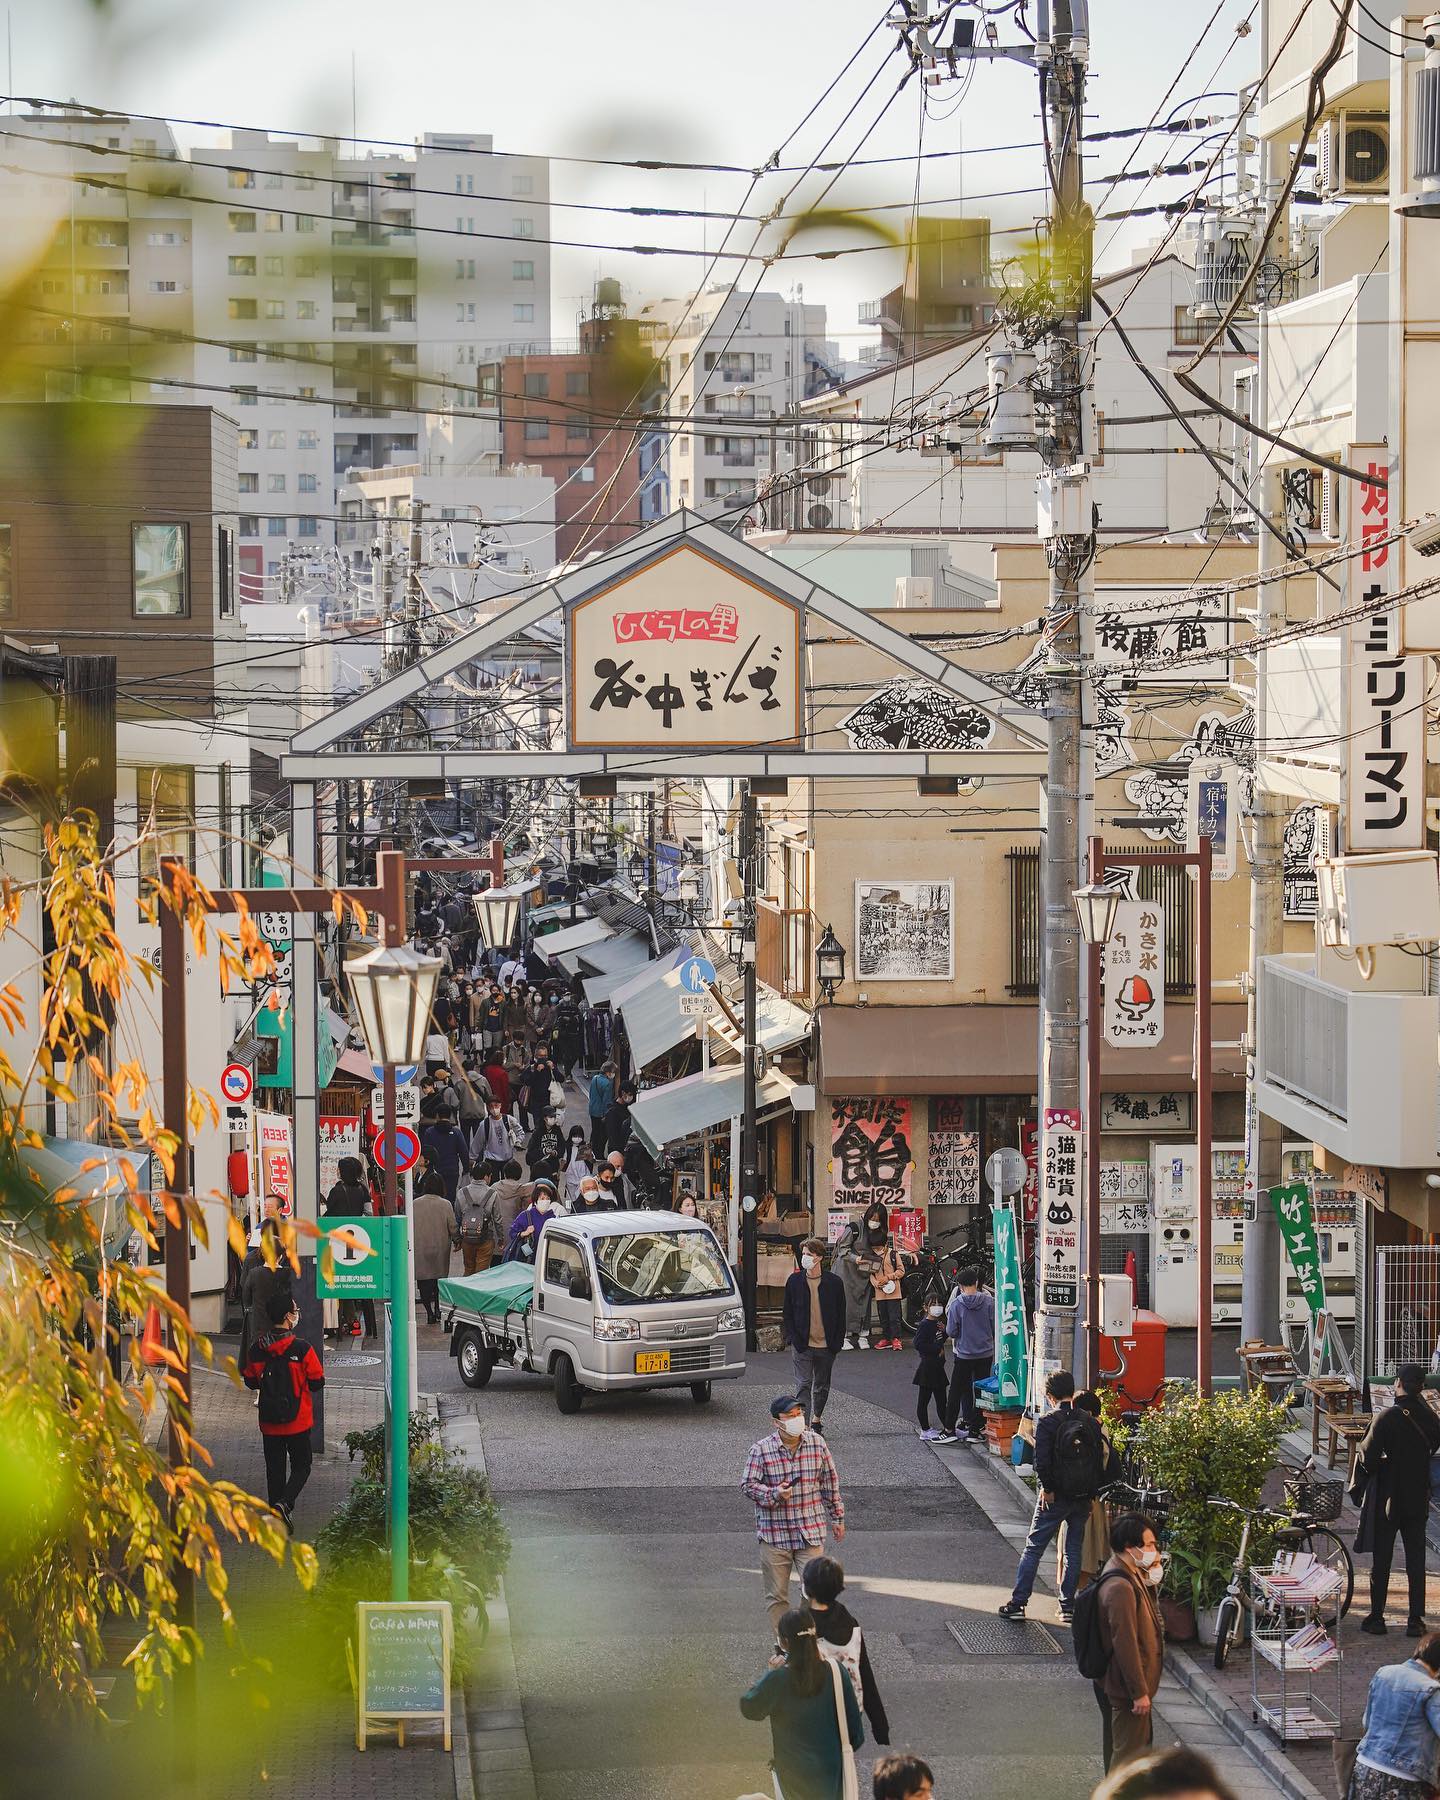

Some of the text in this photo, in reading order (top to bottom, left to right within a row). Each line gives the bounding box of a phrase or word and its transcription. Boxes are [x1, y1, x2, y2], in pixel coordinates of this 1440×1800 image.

[615, 604, 738, 642] ひぐらしの里
[1096, 609, 1207, 659] 後藤の飴
[590, 635, 782, 728] 谷中ぎんざ
[1206, 786, 1220, 849] 宿木カフェ
[1139, 911, 1158, 971] かき氷
[142, 947, 150, 958] 2F
[1112, 949, 1131, 957] すぐ先
[1110, 1021, 1158, 1036] ひみつ堂
[375, 1090, 416, 1102] 自を除く
[375, 1101, 416, 1111] 一通行
[1111, 1092, 1179, 1120] 後藤の飴
[832, 1119, 911, 1189] 飴
[928, 1140, 953, 1156] あんず
[1045, 1147, 1056, 1189] のお店
[1058, 1136, 1076, 1197] 猫雑貨
[928, 1179, 954, 1192] ほうじ茶
[955, 1175, 979, 1193] ゆず
[1123, 1219, 1148, 1230] ちから
[1045, 1236, 1076, 1248] 布風船
[1280, 1193, 1317, 1294] 竹工芸
[1215, 1254, 1239, 1266] FIRE
[1047, 1294, 1069, 1303] 3-13
[645, 1360, 669, 1371] 17-18
